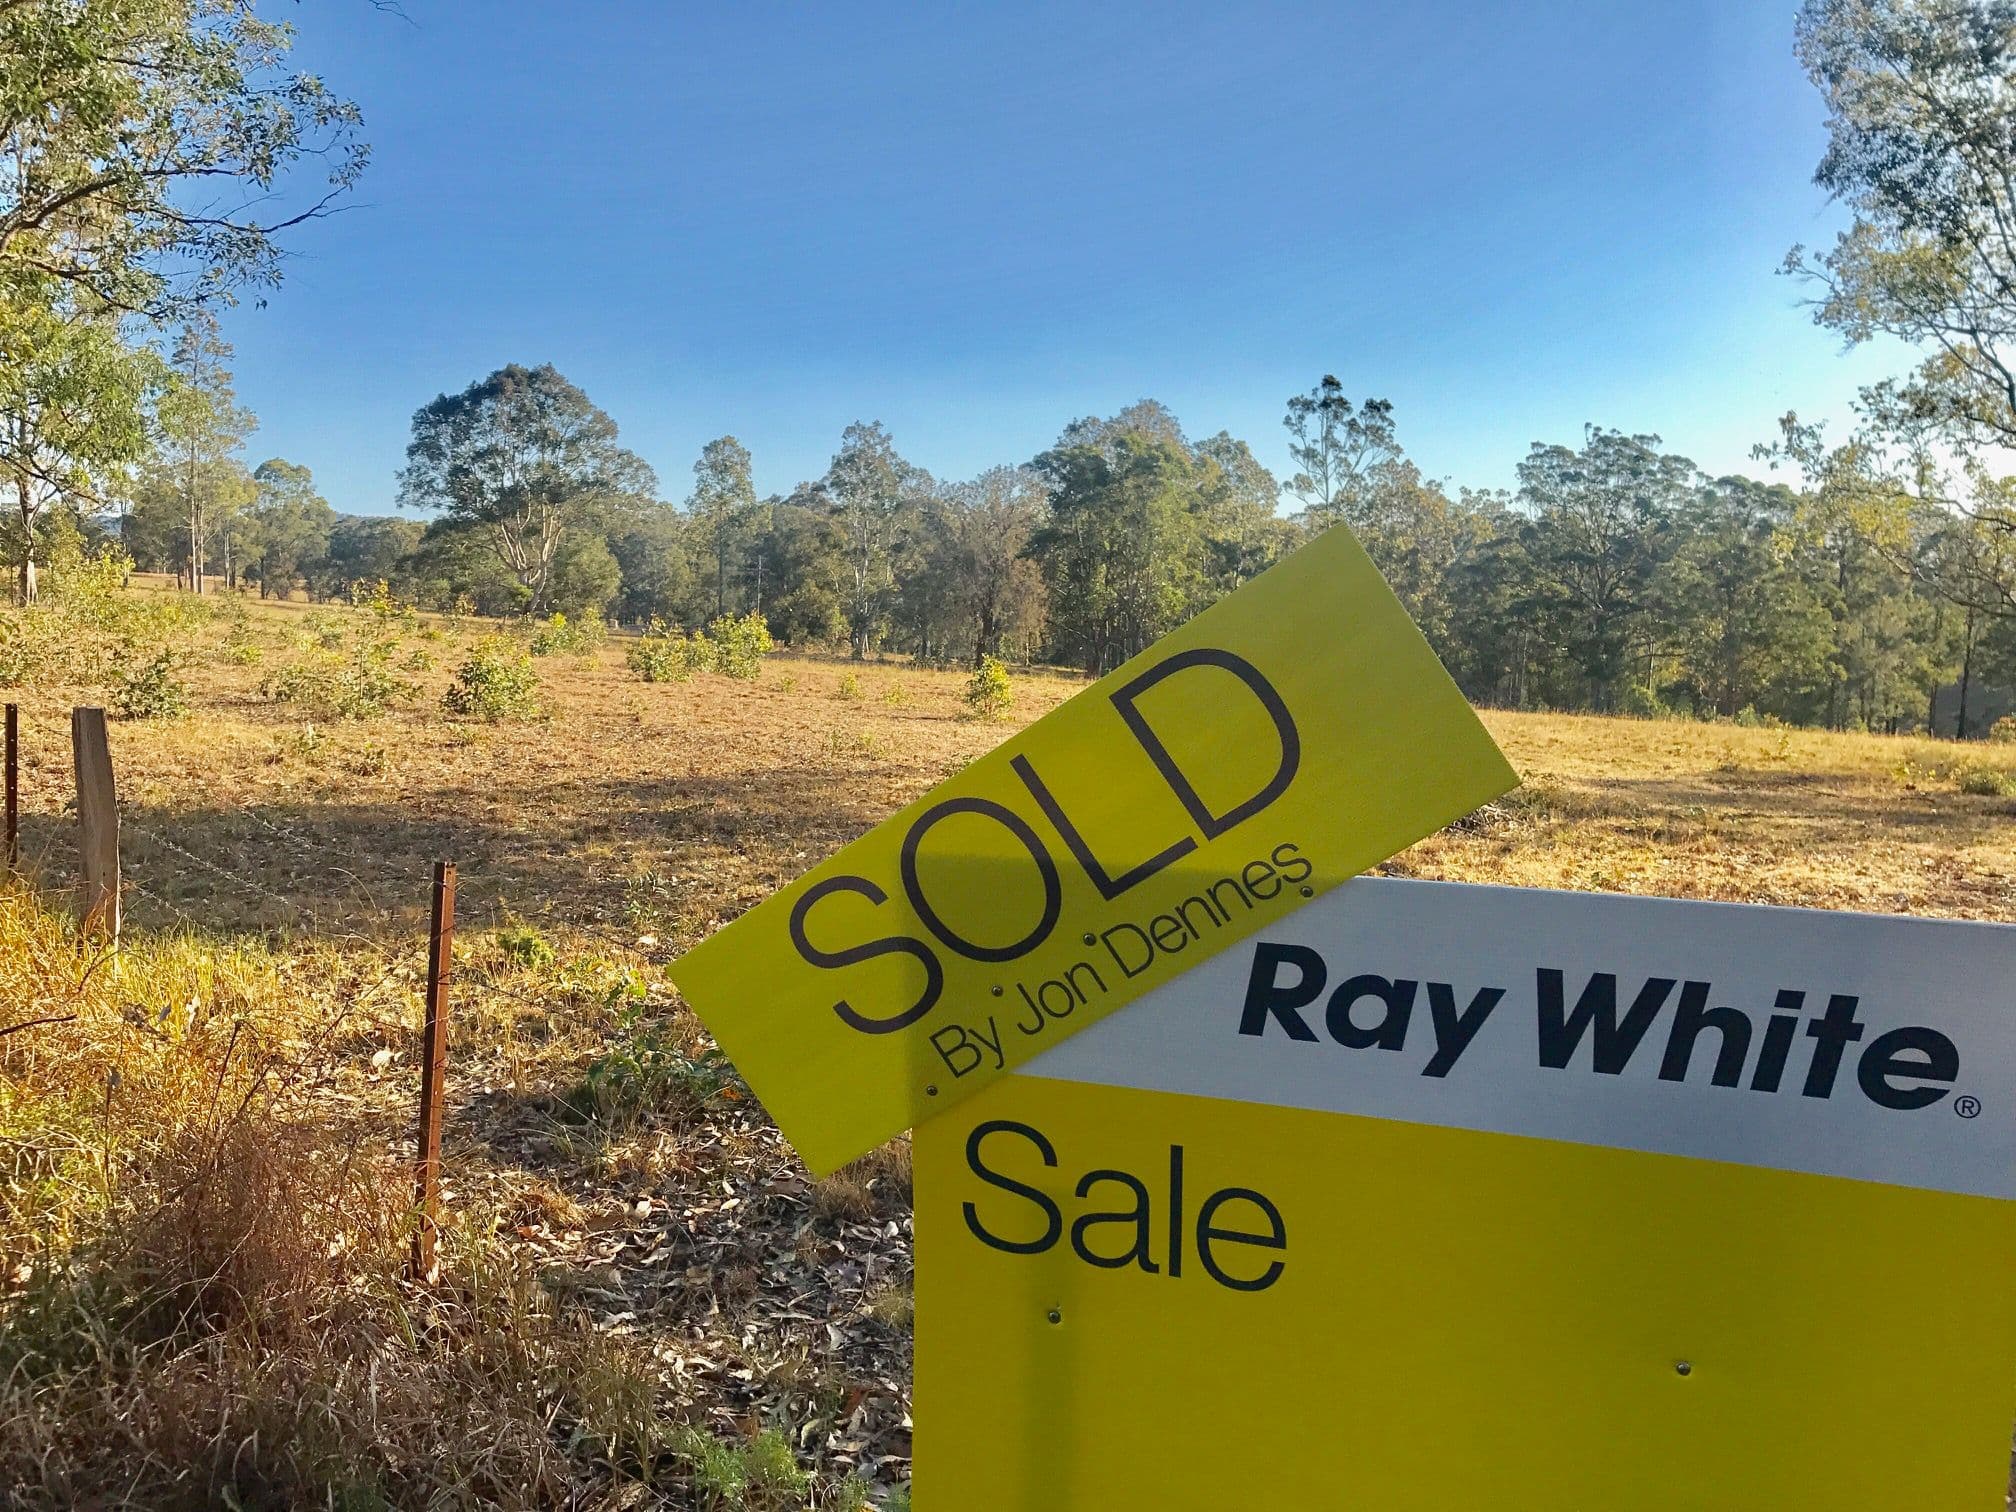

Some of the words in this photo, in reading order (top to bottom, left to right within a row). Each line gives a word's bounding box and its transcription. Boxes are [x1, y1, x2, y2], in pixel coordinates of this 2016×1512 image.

[789, 648, 1301, 1034] SOLD
[930, 1017, 1004, 1079] By
[1016, 960, 1107, 1037] Jon
[1101, 842, 1314, 976] Dennes
[1238, 942, 1506, 1078] Ray
[962, 1119, 1287, 1291] Sale
